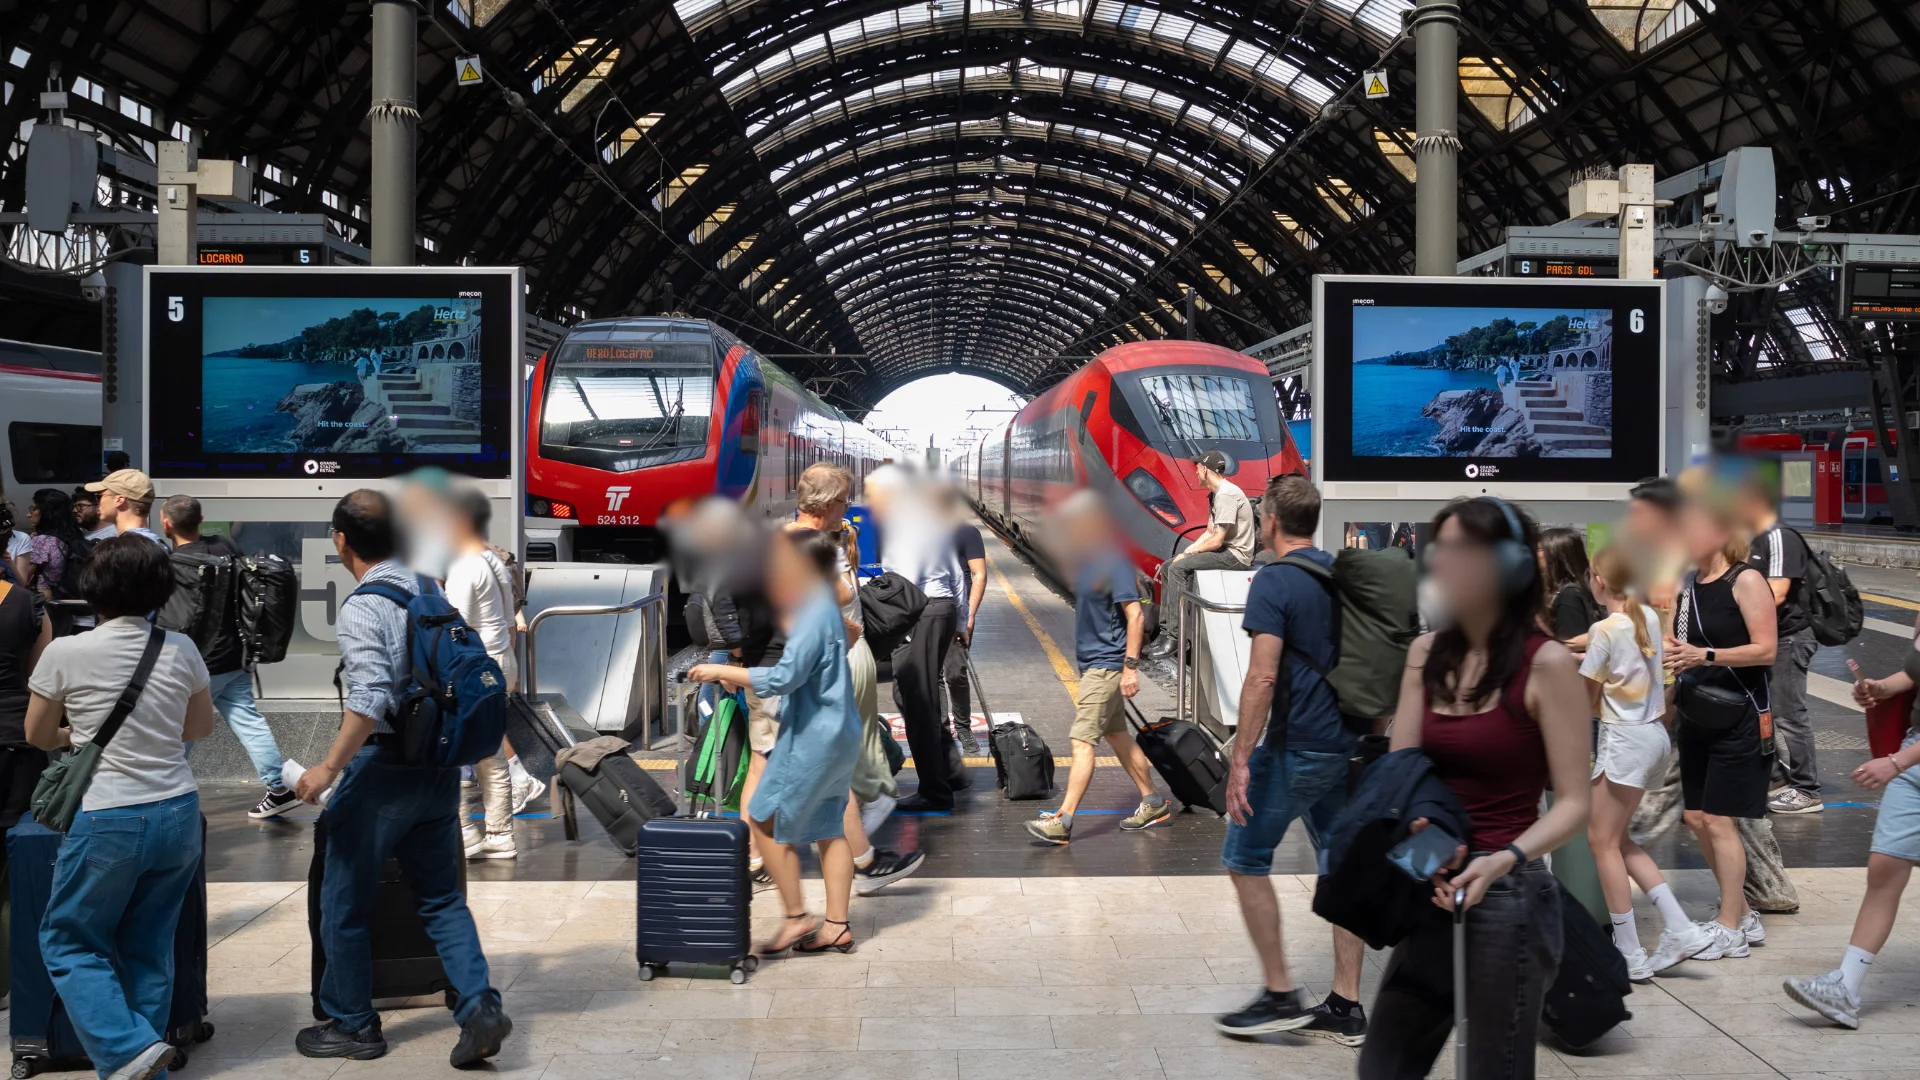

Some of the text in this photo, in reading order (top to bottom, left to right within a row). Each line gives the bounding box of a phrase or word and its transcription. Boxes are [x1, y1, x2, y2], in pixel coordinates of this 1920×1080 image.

[200, 253, 244, 263] LOCARNO
[300, 249, 310, 263] 5
[1521, 261, 1530, 273] 6
[1546, 265, 1594, 275] PARIS GDL
[168, 296, 184, 322] 5
[434, 309, 467, 319] Hertz
[1568, 319, 1599, 329] Hertz
[1630, 308, 1645, 333] 6
[610, 346, 654, 359] Locarno
[597, 515, 640, 525] 524 312
